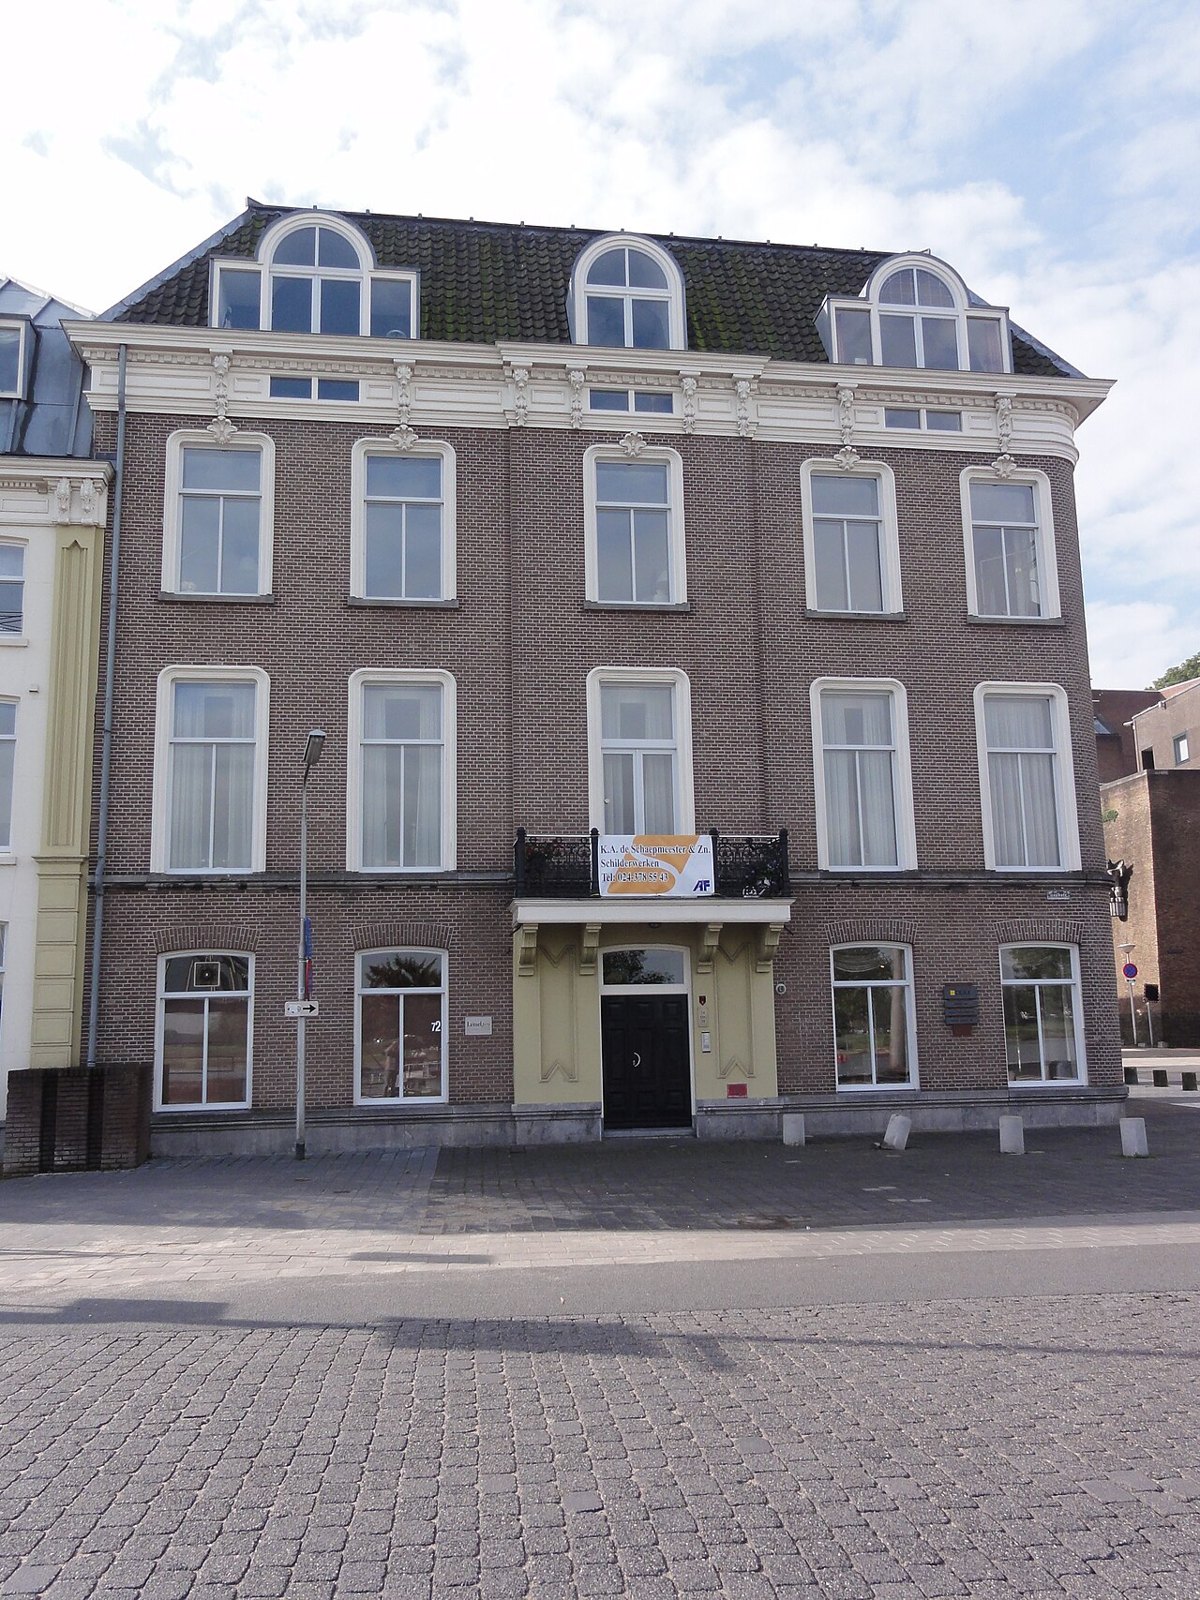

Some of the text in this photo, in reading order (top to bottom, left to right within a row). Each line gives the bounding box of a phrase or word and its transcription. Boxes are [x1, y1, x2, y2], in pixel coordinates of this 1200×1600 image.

[600, 844, 711, 856] K.A. de Schaepmeester & Zn.
[600, 859, 660, 868] Schilderwerken
[649, 873, 657, 882] 55
[660, 873, 669, 881] 43
[431, 1020, 441, 1032] 72
